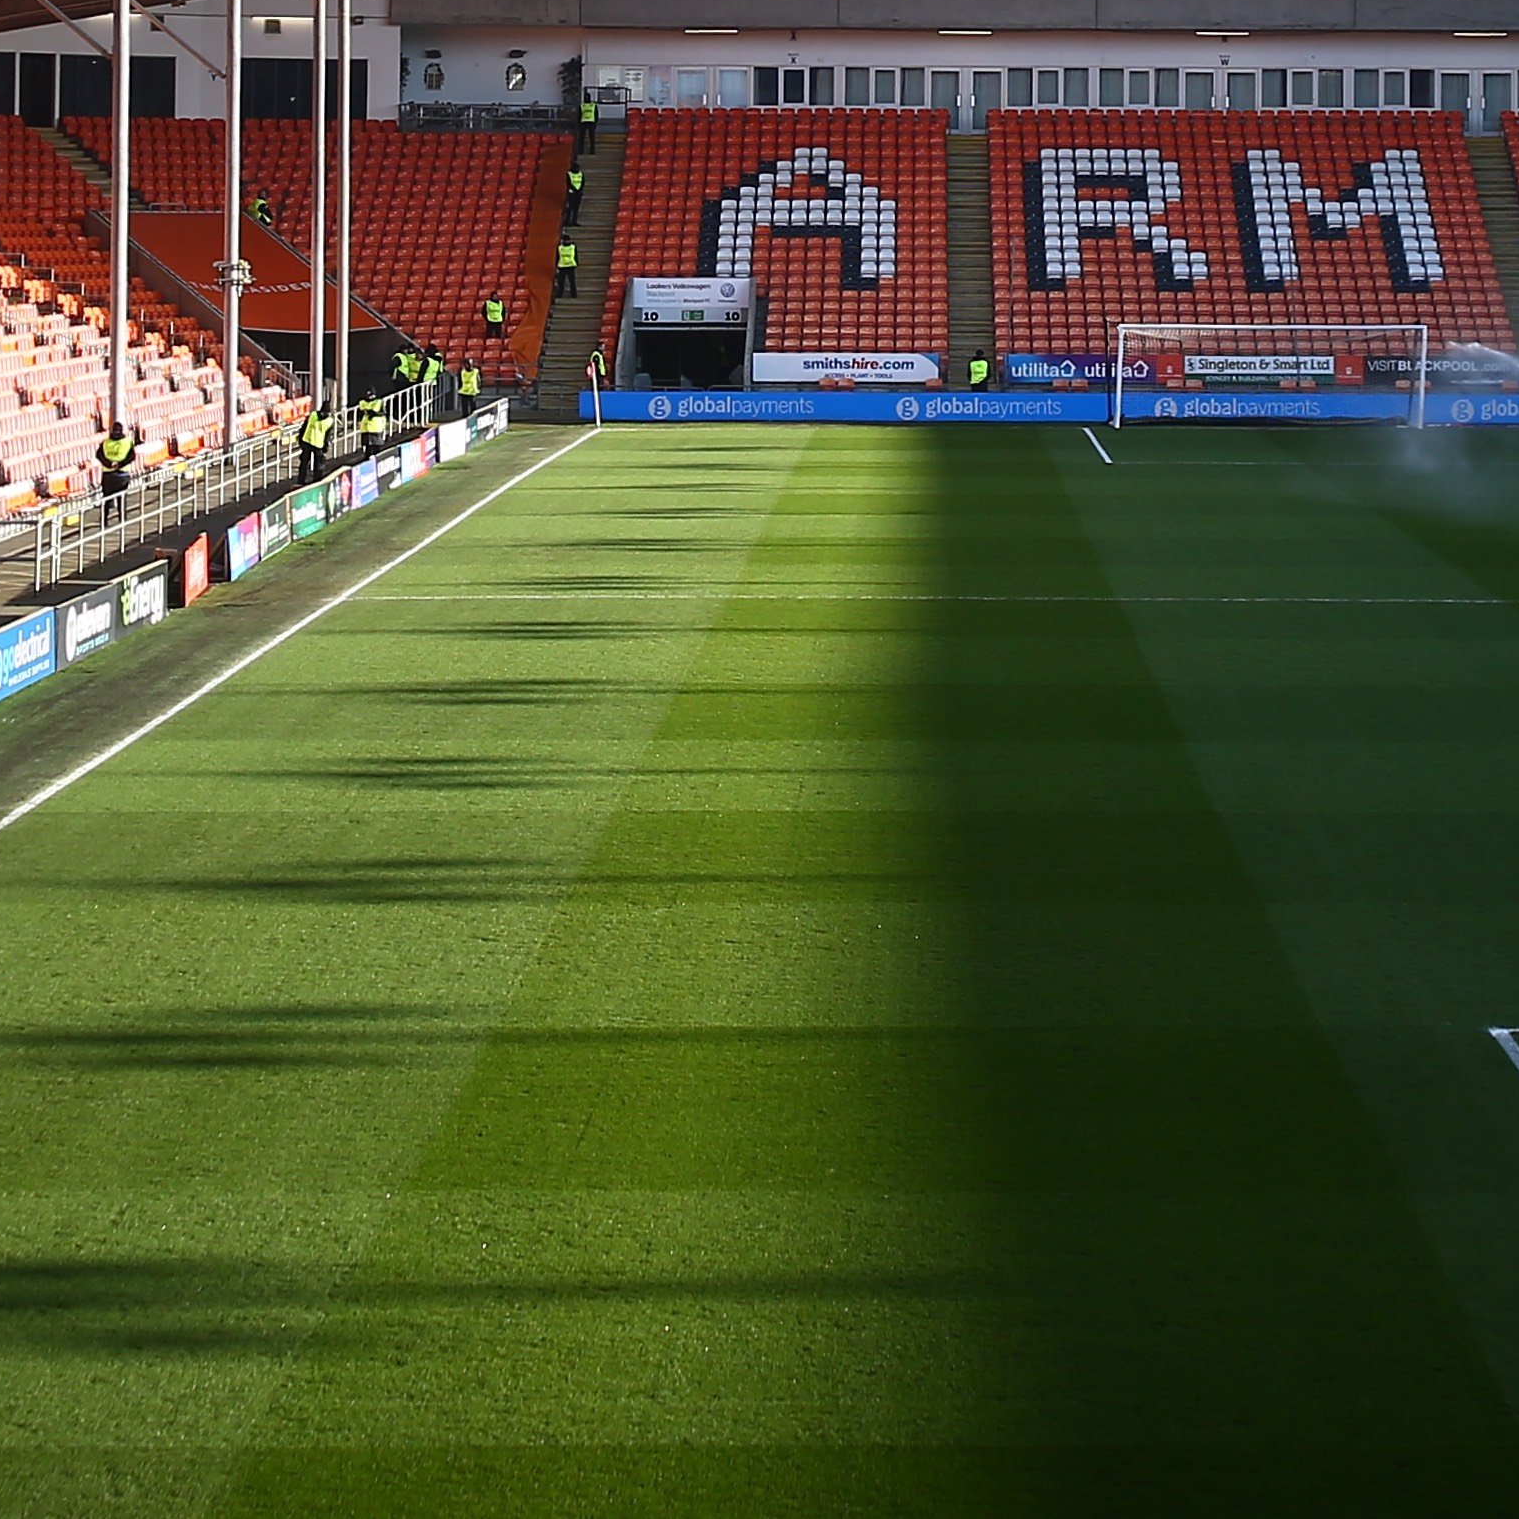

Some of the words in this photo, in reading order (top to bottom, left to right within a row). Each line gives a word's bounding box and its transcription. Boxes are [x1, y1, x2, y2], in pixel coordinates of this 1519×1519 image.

[644, 312, 658, 321] 10
[725, 312, 740, 321] 10
[803, 357, 914, 370] smithshire.com
[1012, 363, 1059, 378] utilita
[1085, 363, 1132, 378] utiia
[1198, 358, 1256, 373] Singleton
[1259, 359, 1270, 371] &
[1273, 359, 1307, 371] Smart
[1310, 359, 1329, 371] Ltd
[678, 394, 814, 419] globalpayments
[926, 396, 1062, 419] globalpayments
